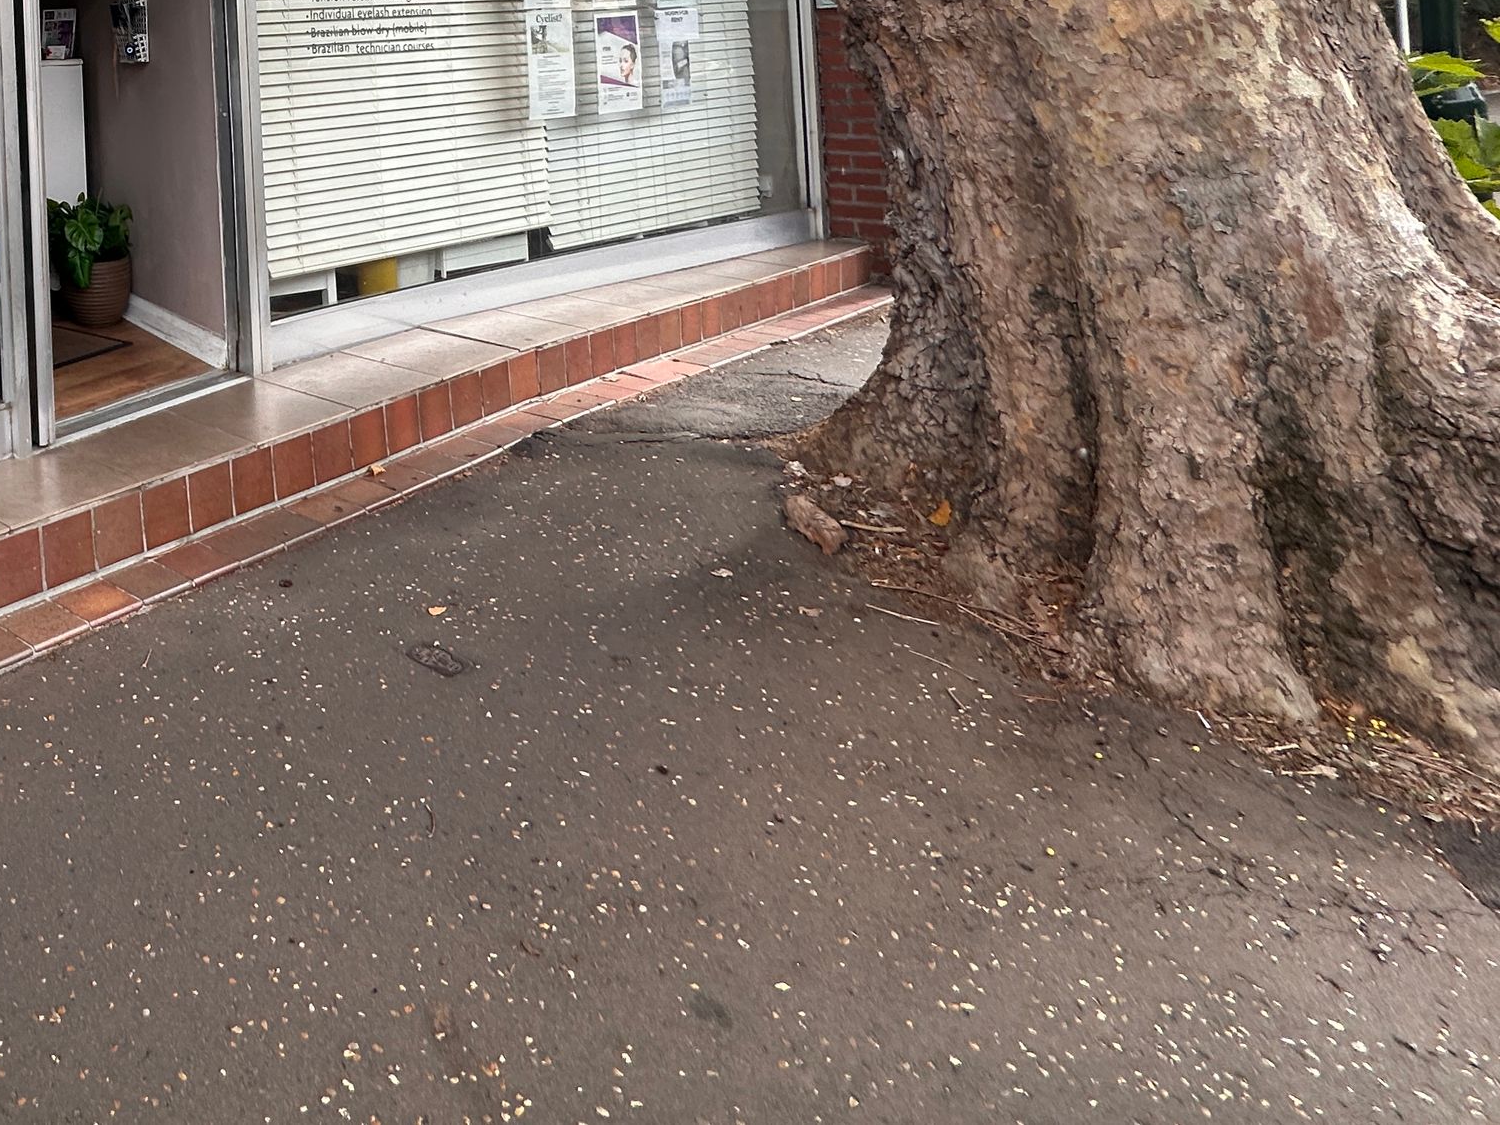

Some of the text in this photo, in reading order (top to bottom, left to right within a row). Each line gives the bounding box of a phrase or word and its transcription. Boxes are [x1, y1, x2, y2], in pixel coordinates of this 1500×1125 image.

[310, 6, 433, 21] Individual eyelash extension
[536, 14, 563, 24] Cyclist?
[311, 43, 350, 55] Brazilian
[356, 41, 400, 54] technician
